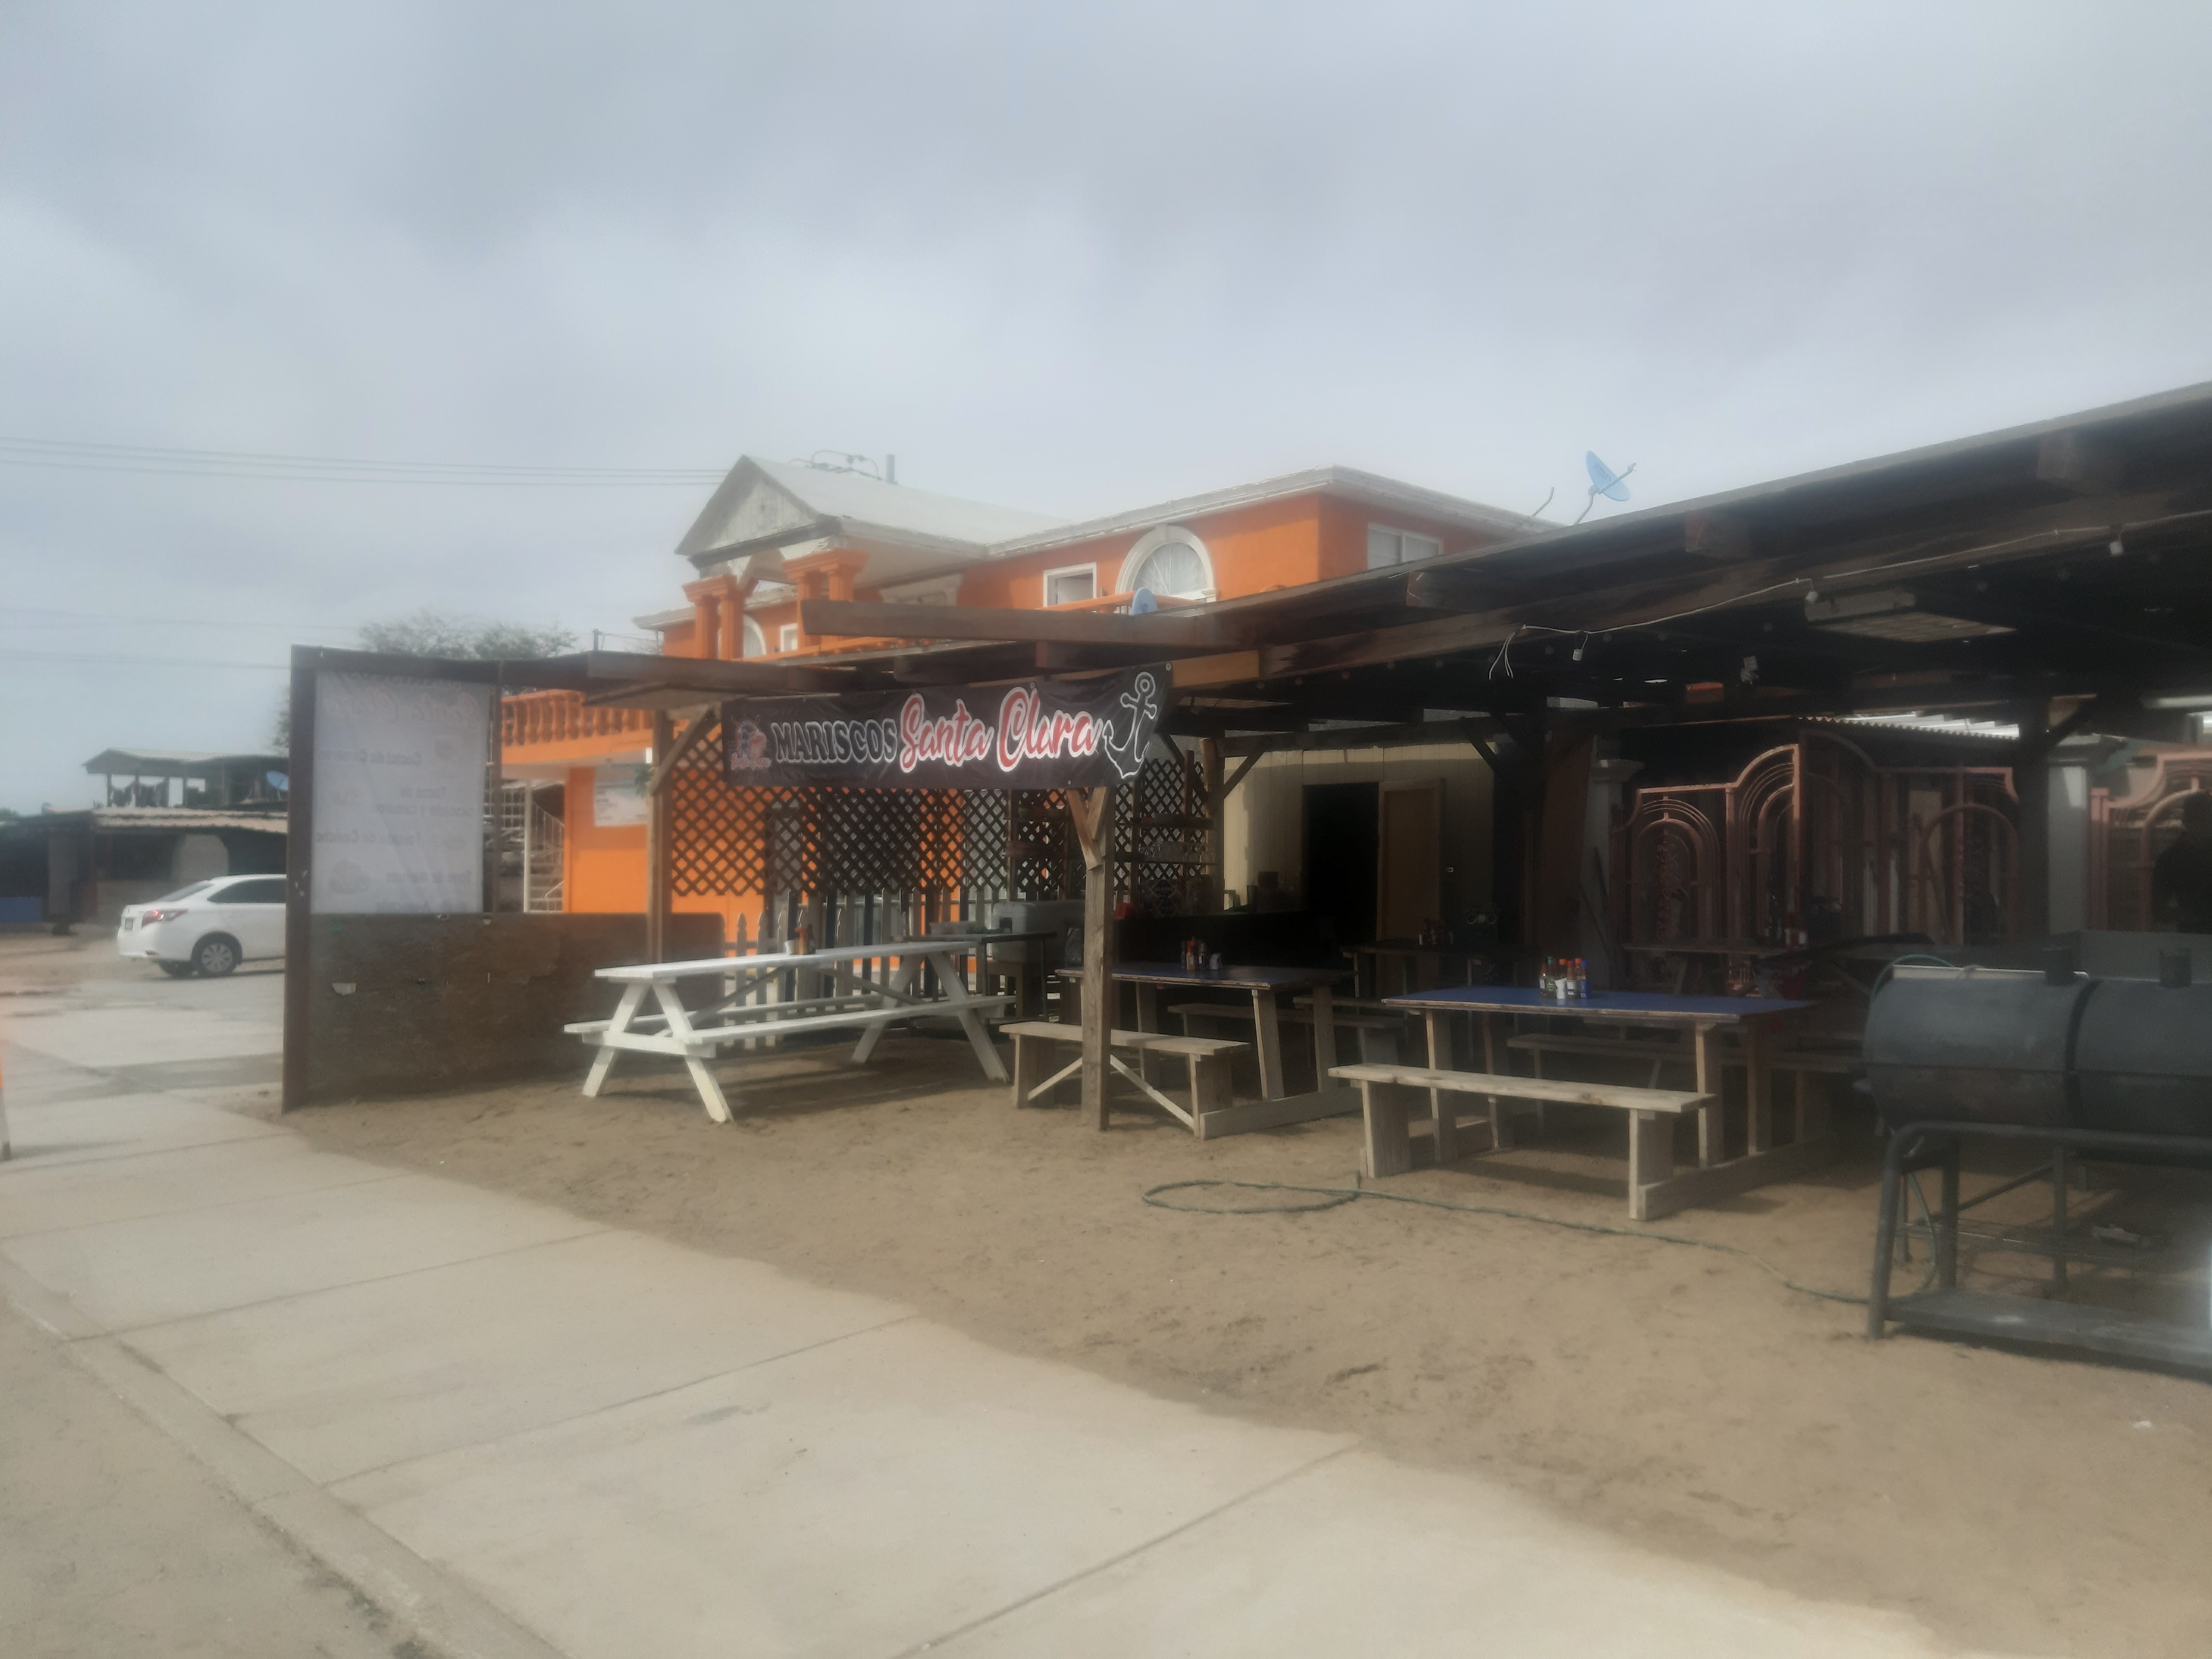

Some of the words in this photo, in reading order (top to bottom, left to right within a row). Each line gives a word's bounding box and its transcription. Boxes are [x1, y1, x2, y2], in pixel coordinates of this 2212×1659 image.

[771, 718, 898, 763] MARISCOS
[900, 693, 994, 773] Santa
[997, 686, 1103, 772] Clara
